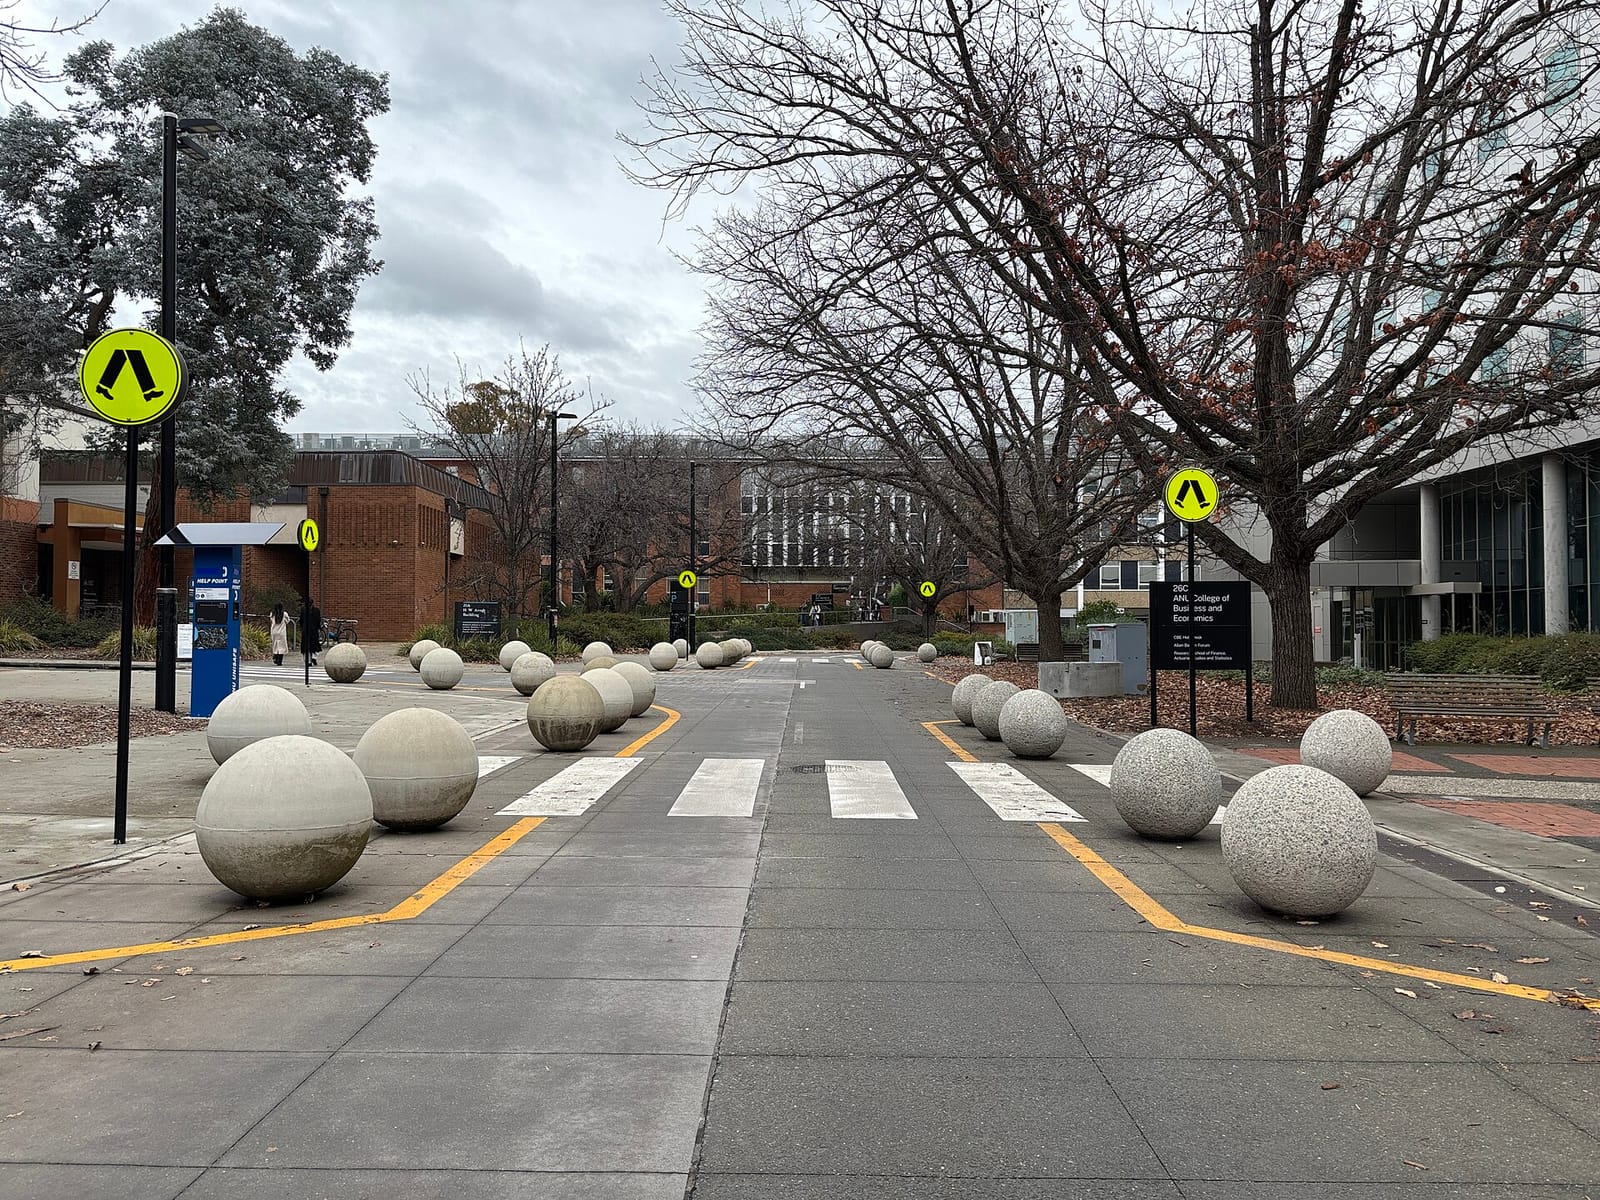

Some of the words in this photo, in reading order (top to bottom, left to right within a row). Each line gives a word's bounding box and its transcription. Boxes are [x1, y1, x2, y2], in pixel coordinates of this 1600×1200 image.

[1172, 584, 1189, 592] 26C
[1221, 594, 1230, 602] of
[1173, 604, 1207, 612] Busiess
[1207, 604, 1223, 612] and
